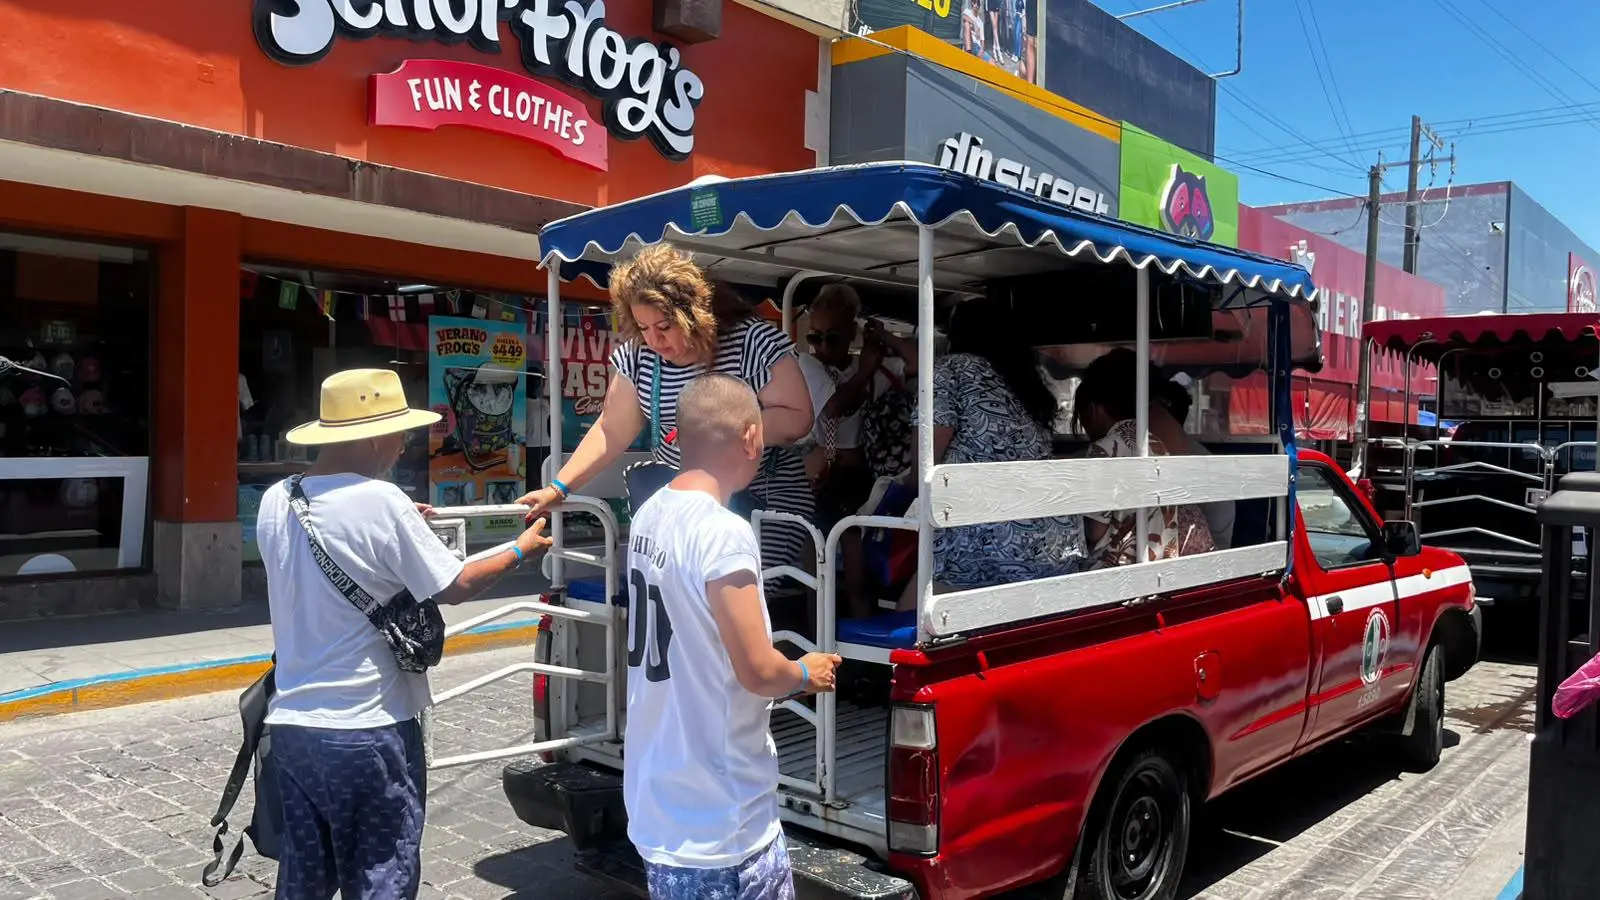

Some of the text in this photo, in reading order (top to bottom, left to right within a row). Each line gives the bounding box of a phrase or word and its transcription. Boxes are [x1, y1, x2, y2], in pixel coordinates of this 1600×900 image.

[407, 77, 463, 112] FUN
[488, 84, 588, 145] CLOTHES
[436, 328, 487, 343] VERANO
[436, 341, 480, 356] FROG'S
[492, 344, 523, 357] $449
